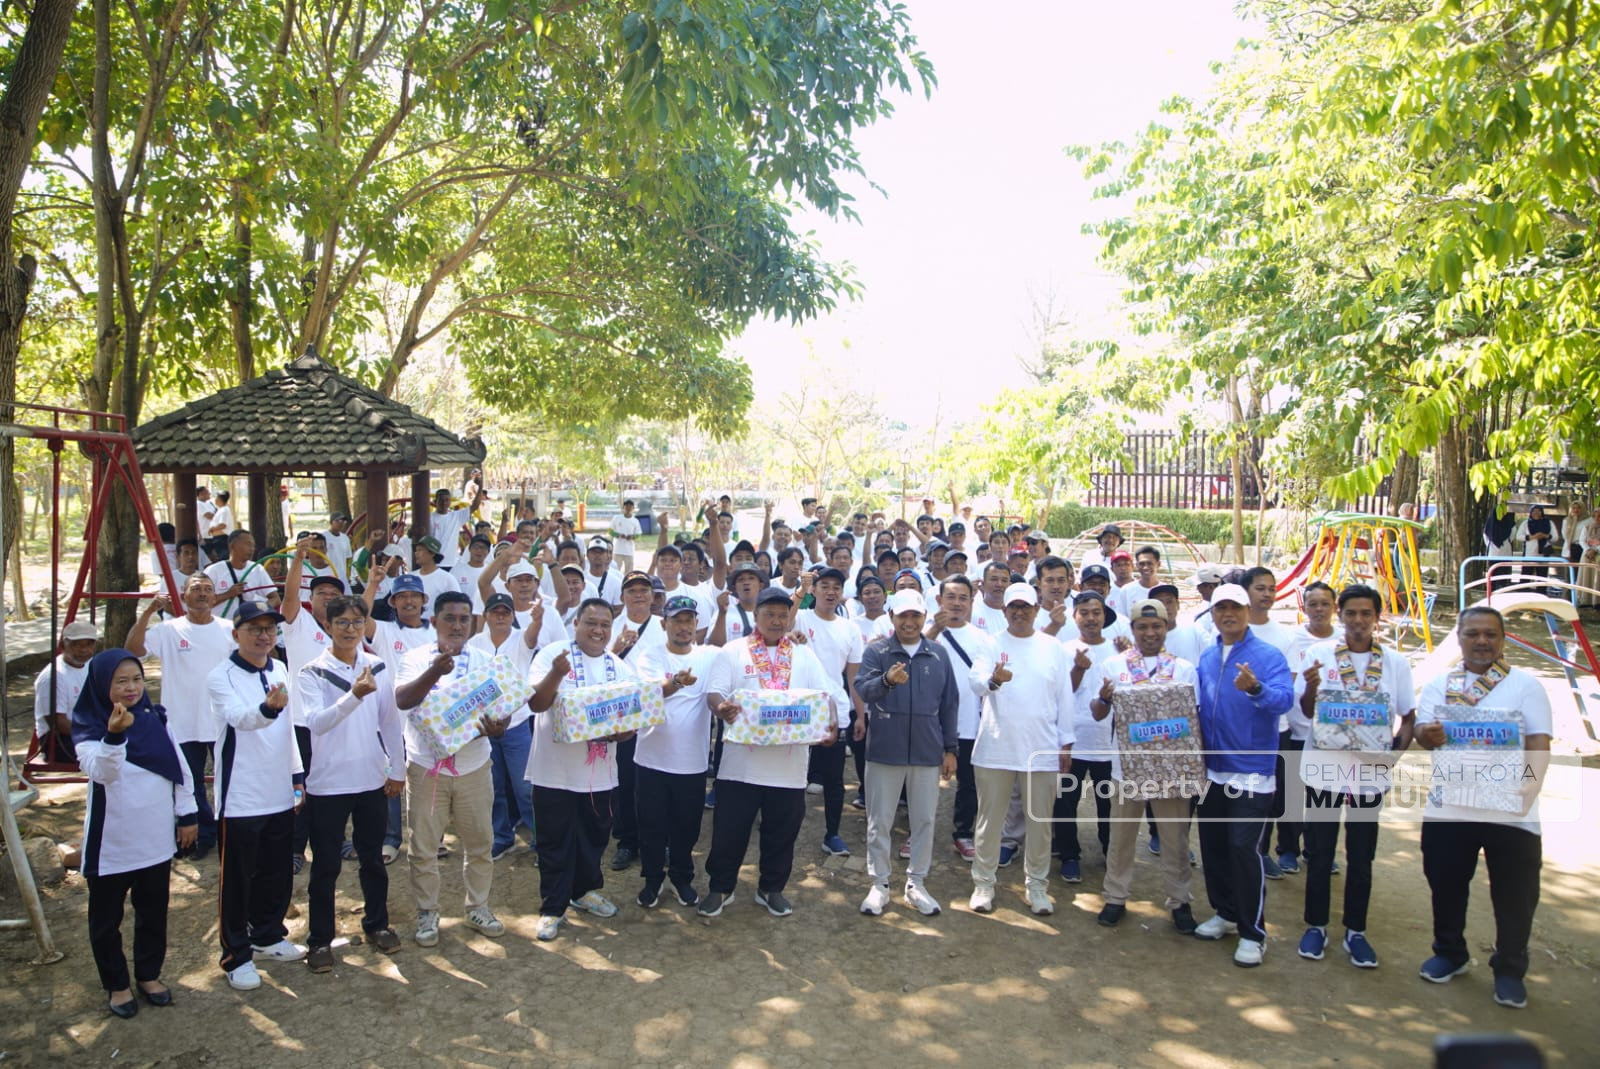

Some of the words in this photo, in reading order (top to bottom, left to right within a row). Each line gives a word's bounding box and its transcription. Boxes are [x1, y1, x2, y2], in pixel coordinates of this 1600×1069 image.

[447, 689, 488, 721] HARAPAN
[588, 701, 629, 718] HARAPAN
[761, 710, 799, 718] HARAPAN
[1328, 708, 1365, 719] JUARA
[1370, 710, 1377, 720] 2
[1138, 725, 1170, 737] JUARA
[1452, 727, 1493, 738] JUARA
